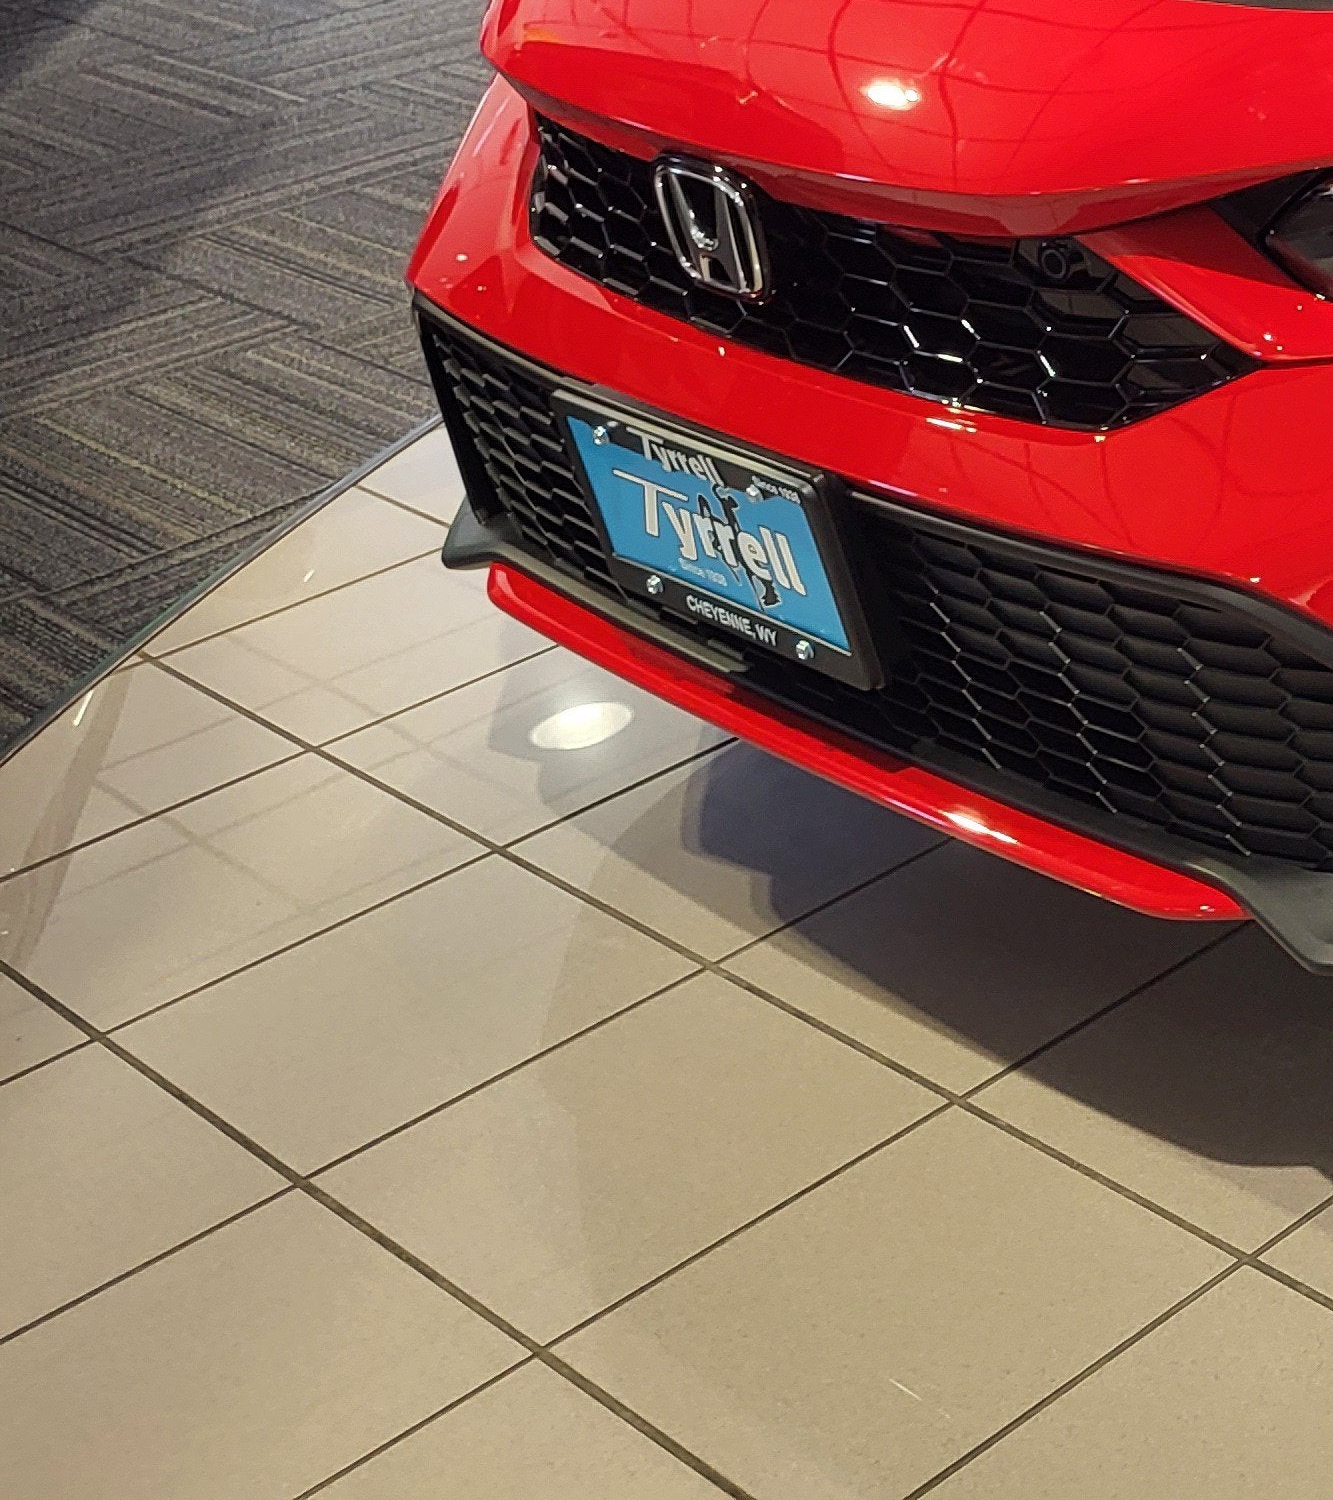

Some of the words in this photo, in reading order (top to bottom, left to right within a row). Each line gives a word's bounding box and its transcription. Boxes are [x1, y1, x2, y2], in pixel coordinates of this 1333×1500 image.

[626, 425, 725, 487] Tyrrell
[612, 468, 807, 596] Tyrrell
[686, 594, 757, 640] CHEYENNE,
[754, 623, 777, 647] WY
